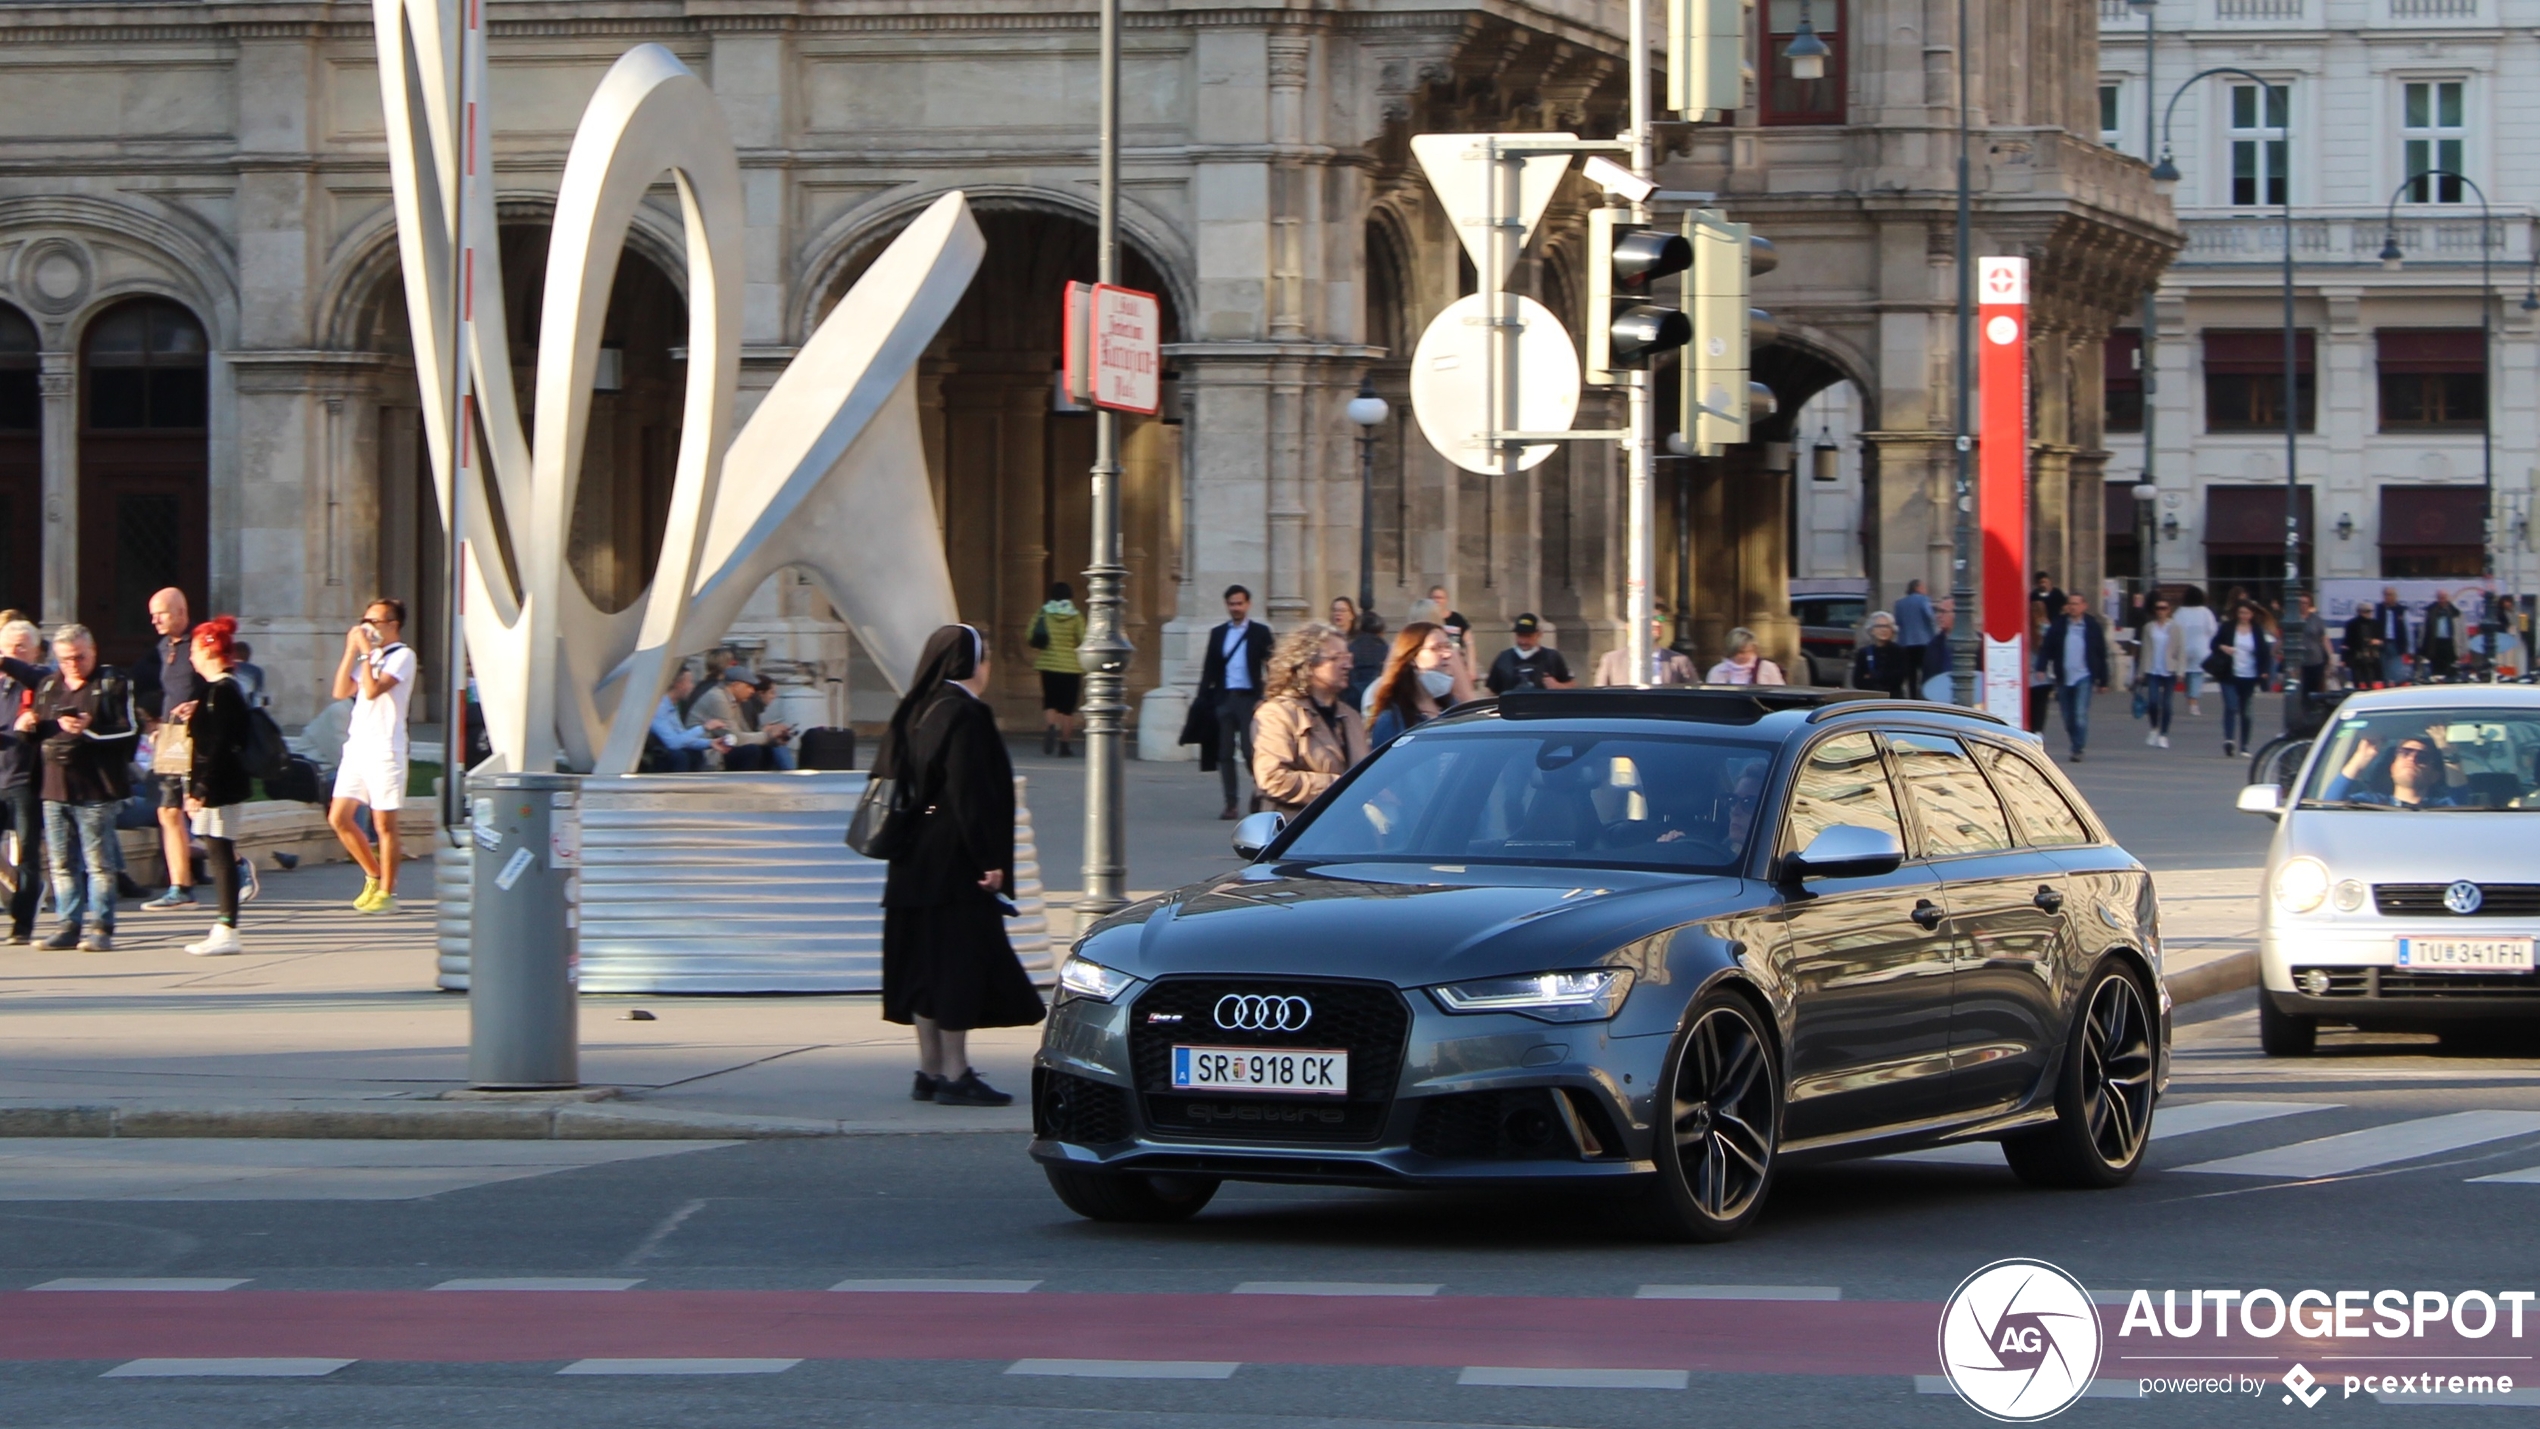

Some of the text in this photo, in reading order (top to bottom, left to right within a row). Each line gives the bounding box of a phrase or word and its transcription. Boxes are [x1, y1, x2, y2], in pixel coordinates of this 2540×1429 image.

[2418, 942, 2442, 962] TU
[1198, 1054, 1334, 1086] SR 918 CK
[1187, 1103, 1345, 1123] quattro
